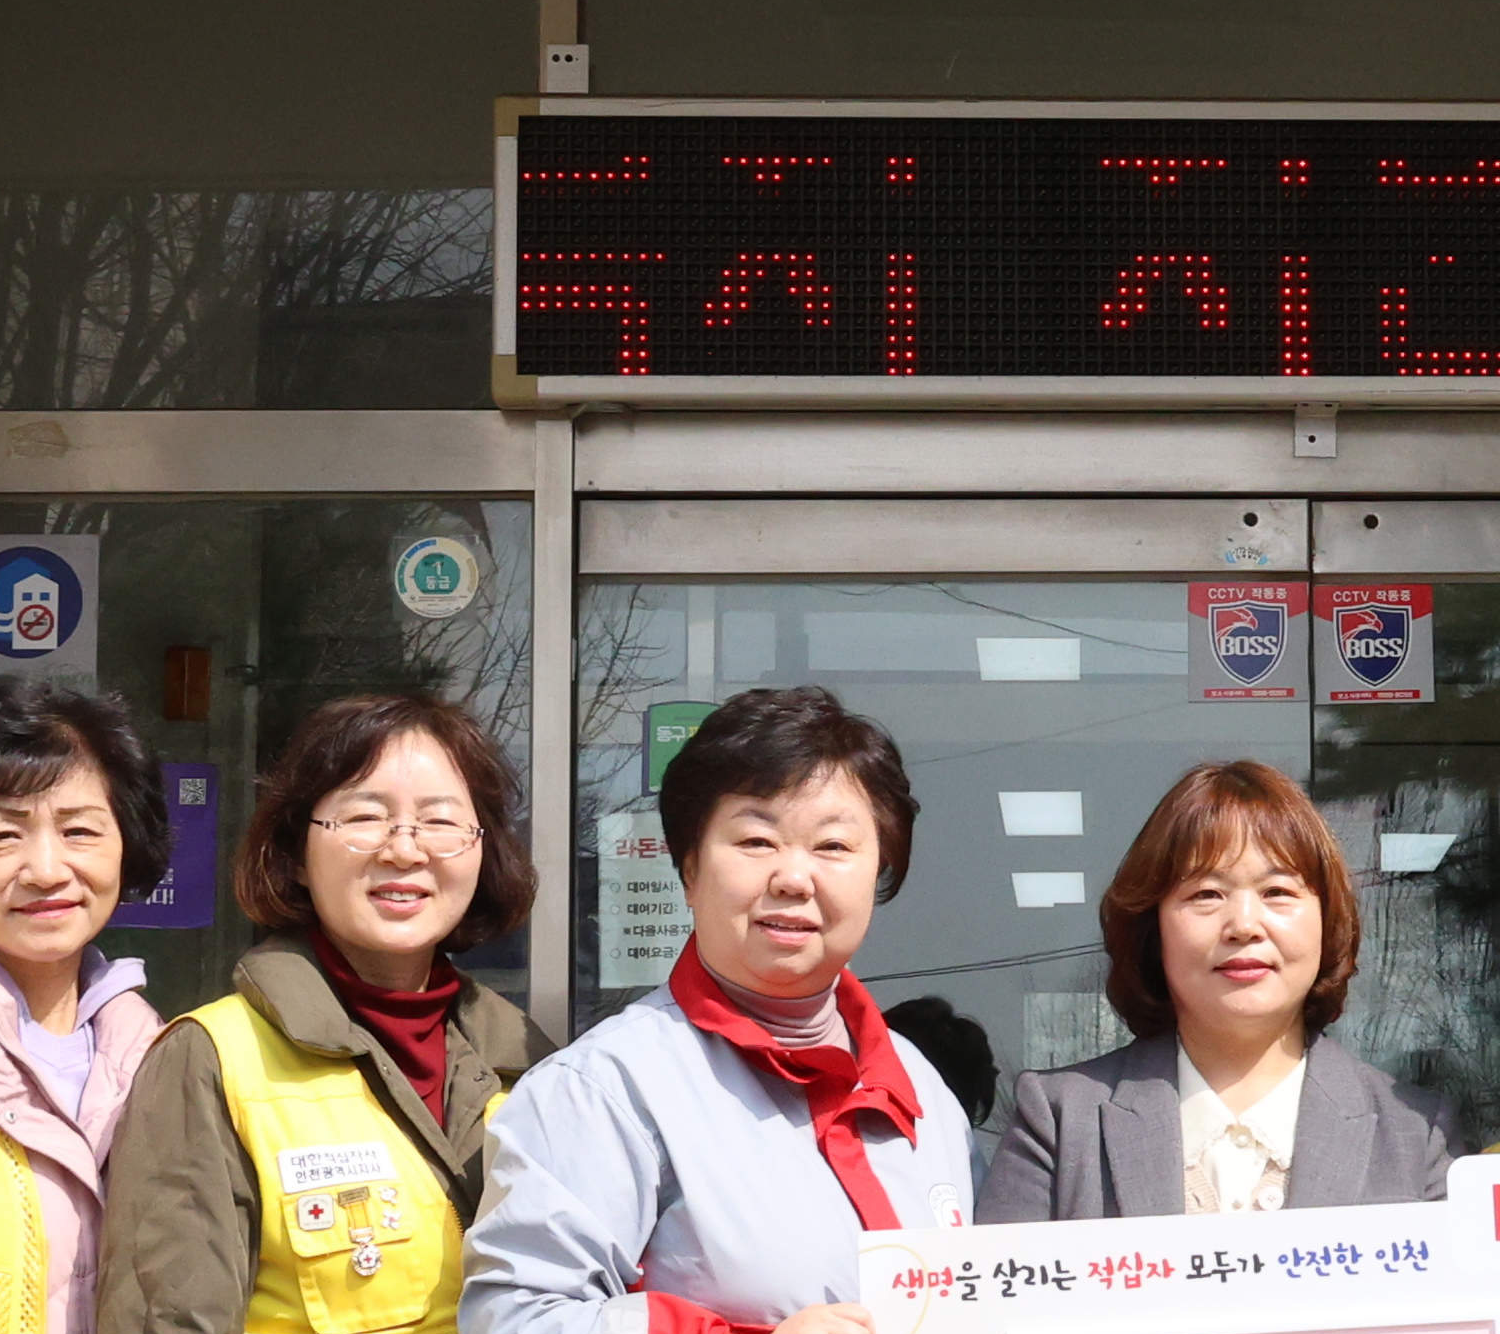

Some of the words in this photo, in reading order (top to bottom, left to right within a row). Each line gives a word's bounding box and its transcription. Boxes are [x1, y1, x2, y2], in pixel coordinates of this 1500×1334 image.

[1208, 588, 1245, 599] CCTV
[1252, 588, 1287, 599] 작동중
[1333, 590, 1369, 602] CCTV
[1376, 590, 1411, 601] 작동중
[1220, 636, 1277, 656] BOSS
[1346, 639, 1402, 658] BOSS
[891, 1261, 981, 1302] 생명을
[992, 1258, 1077, 1298] 살리는
[1087, 1252, 1176, 1289] 적십자
[1186, 1250, 1266, 1284] 모두가
[1277, 1246, 1362, 1279] 안전한
[1375, 1239, 1430, 1274] 인천
